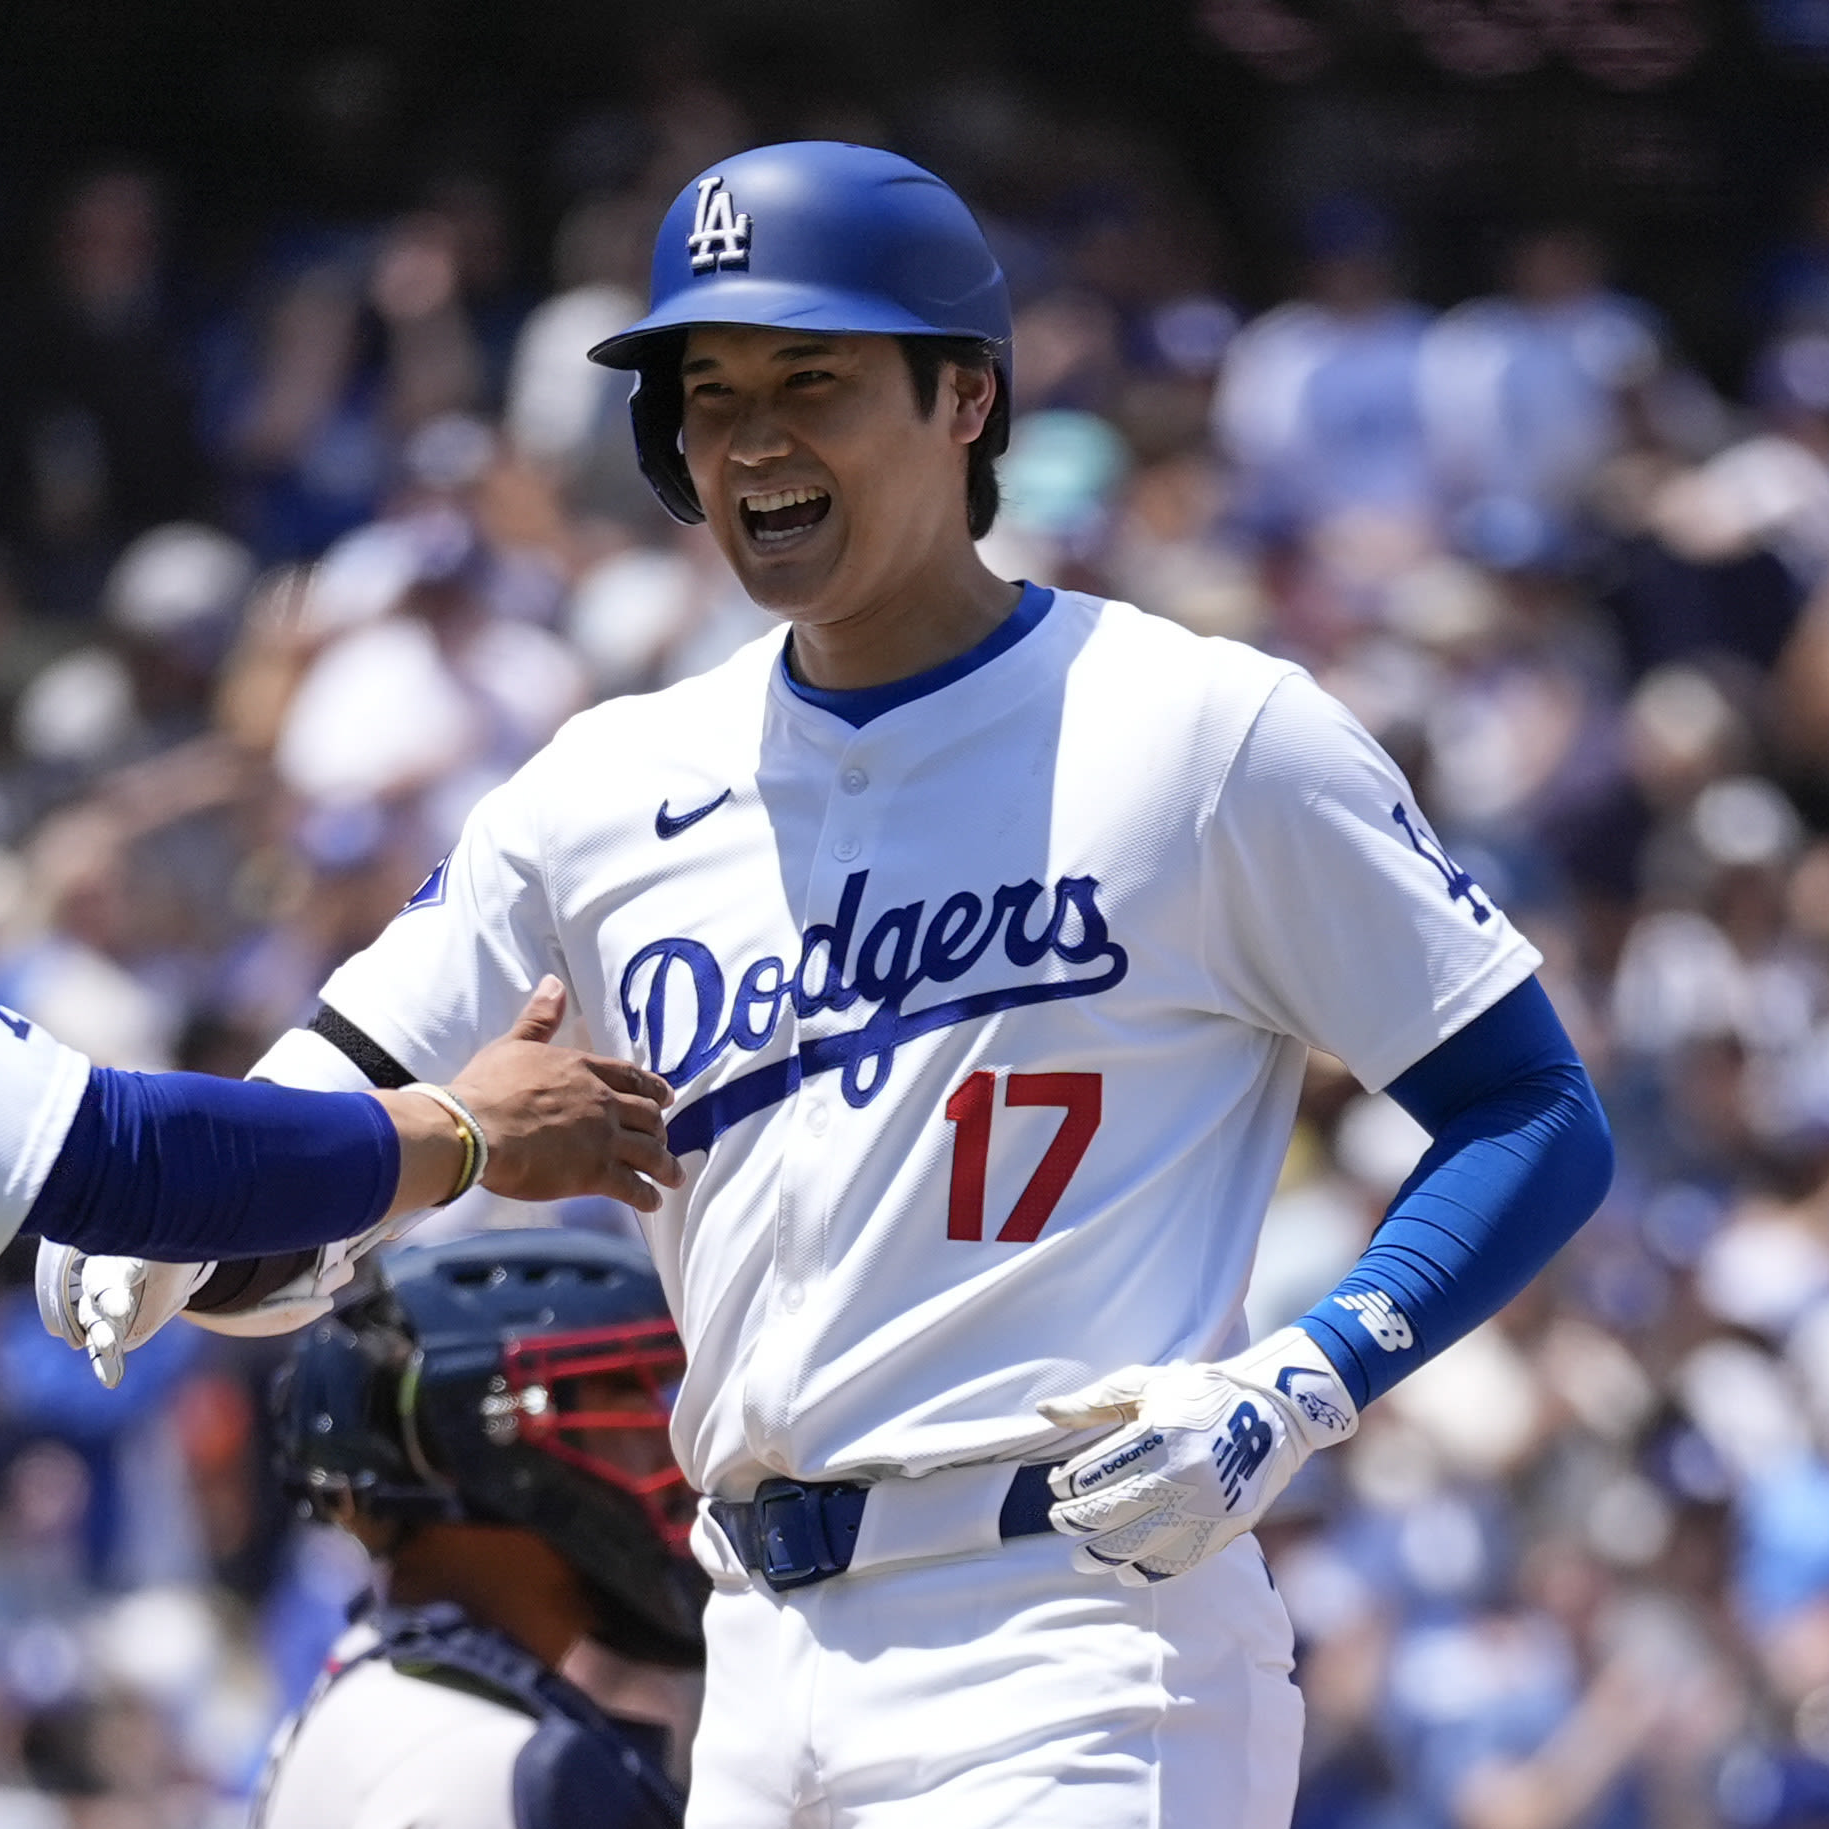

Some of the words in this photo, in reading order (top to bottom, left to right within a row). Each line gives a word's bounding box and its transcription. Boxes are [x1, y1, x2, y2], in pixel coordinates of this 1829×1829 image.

[688, 176, 750, 266] LA
[620, 869, 1128, 1109] Dodgers
[945, 1070, 1103, 1242] 17
[1079, 1469, 1103, 1489] new
[1101, 1434, 1164, 1476] balance
